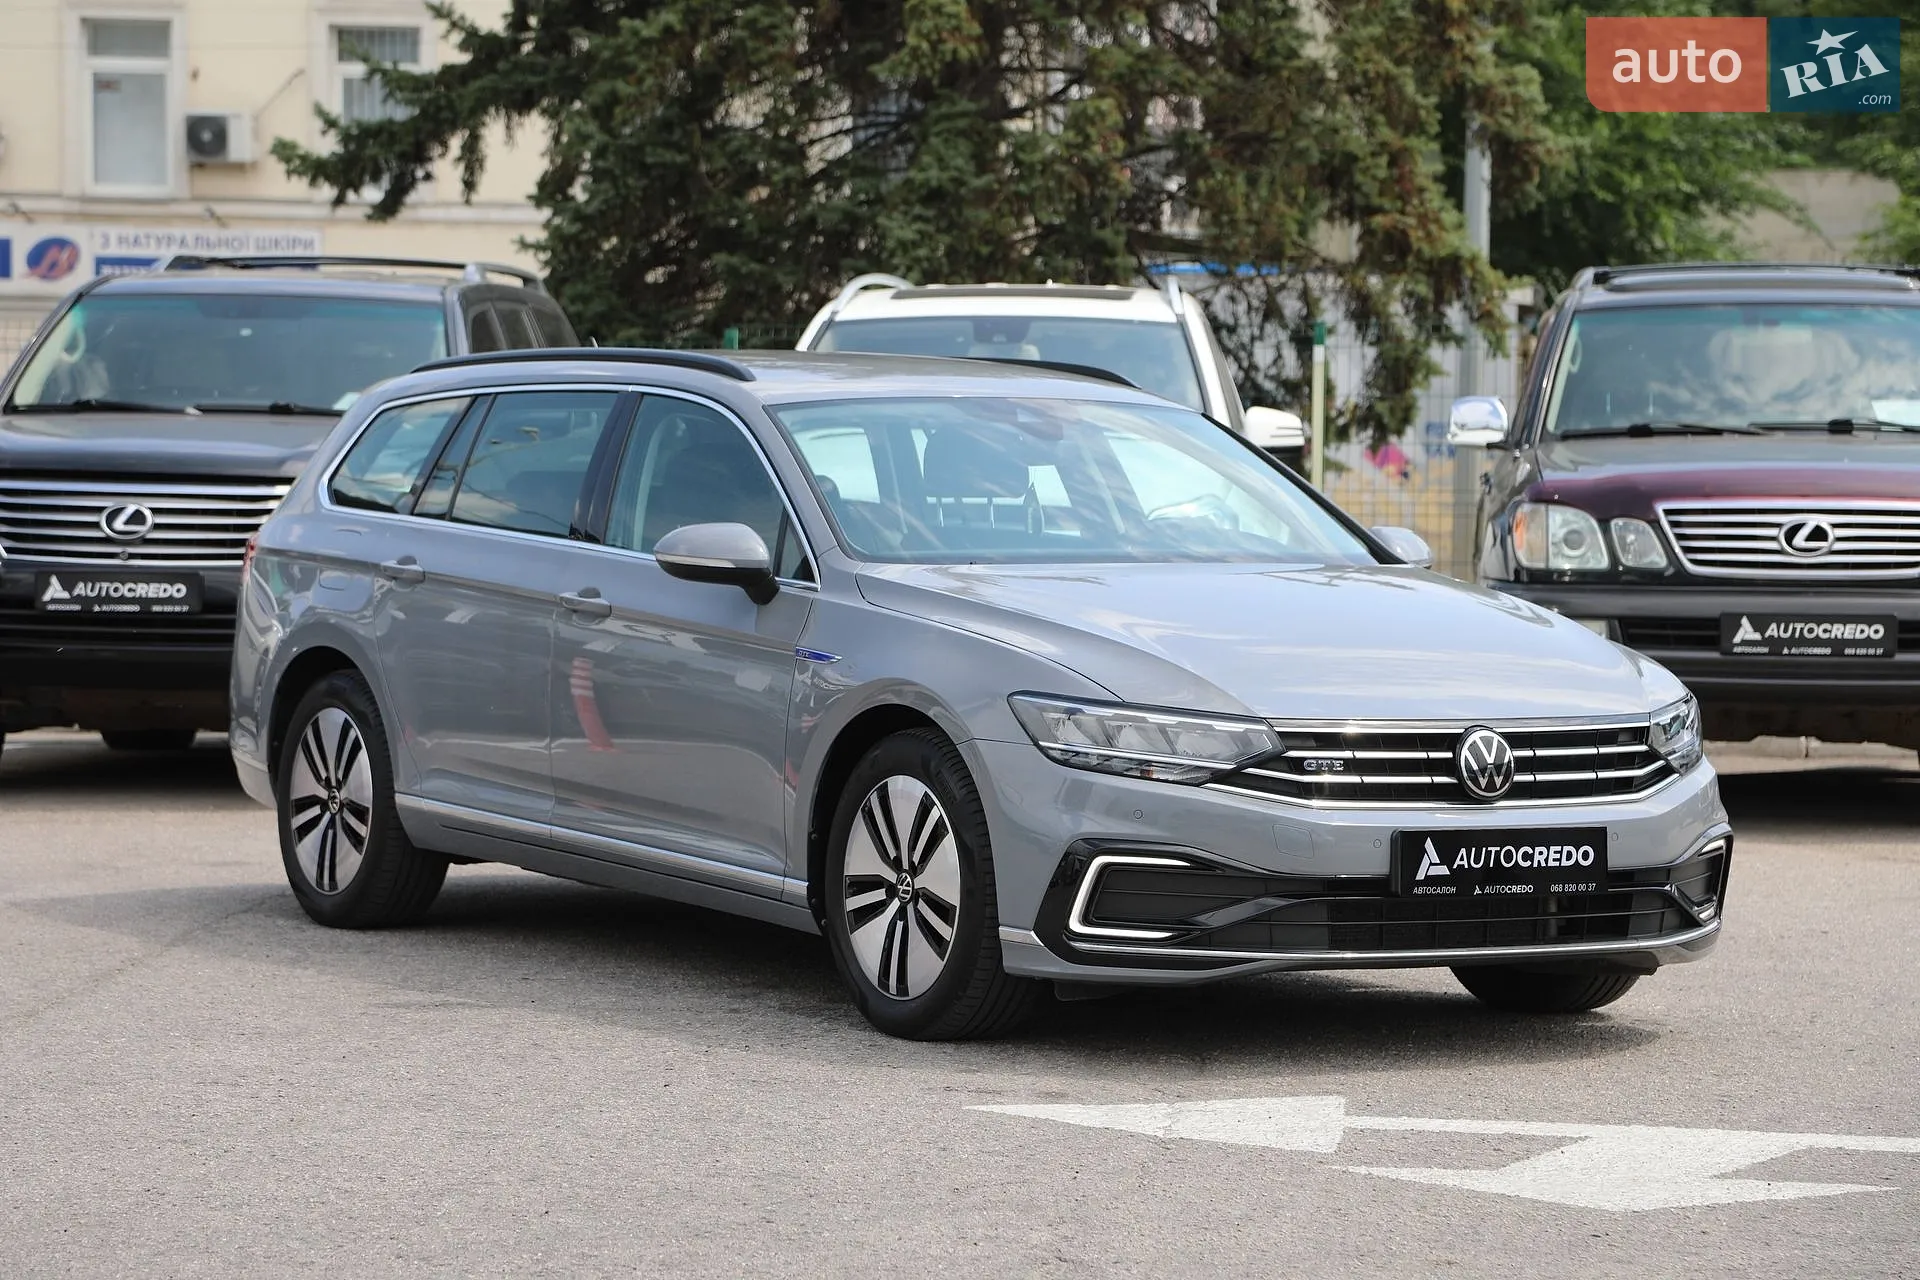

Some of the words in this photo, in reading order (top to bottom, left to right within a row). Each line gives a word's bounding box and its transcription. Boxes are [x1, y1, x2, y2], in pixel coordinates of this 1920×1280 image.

[117, 231, 250, 252] НАТУРАЛЬНОЇ
[256, 232, 315, 252] ШКІРИ
[72, 581, 188, 599] AUTOCREDO
[1765, 622, 1885, 640] AUTOCREDO
[1303, 759, 1344, 771] GTE
[1453, 845, 1595, 869] AUTOCREDO
[1412, 886, 1457, 895] АВТОСАЛОН
[1484, 884, 1534, 894] AUTOCREDO
[1550, 884, 1563, 892] 068
[1564, 883, 1577, 892] 820
[1578, 883, 1587, 891] 00
[1587, 883, 1597, 891] 37
